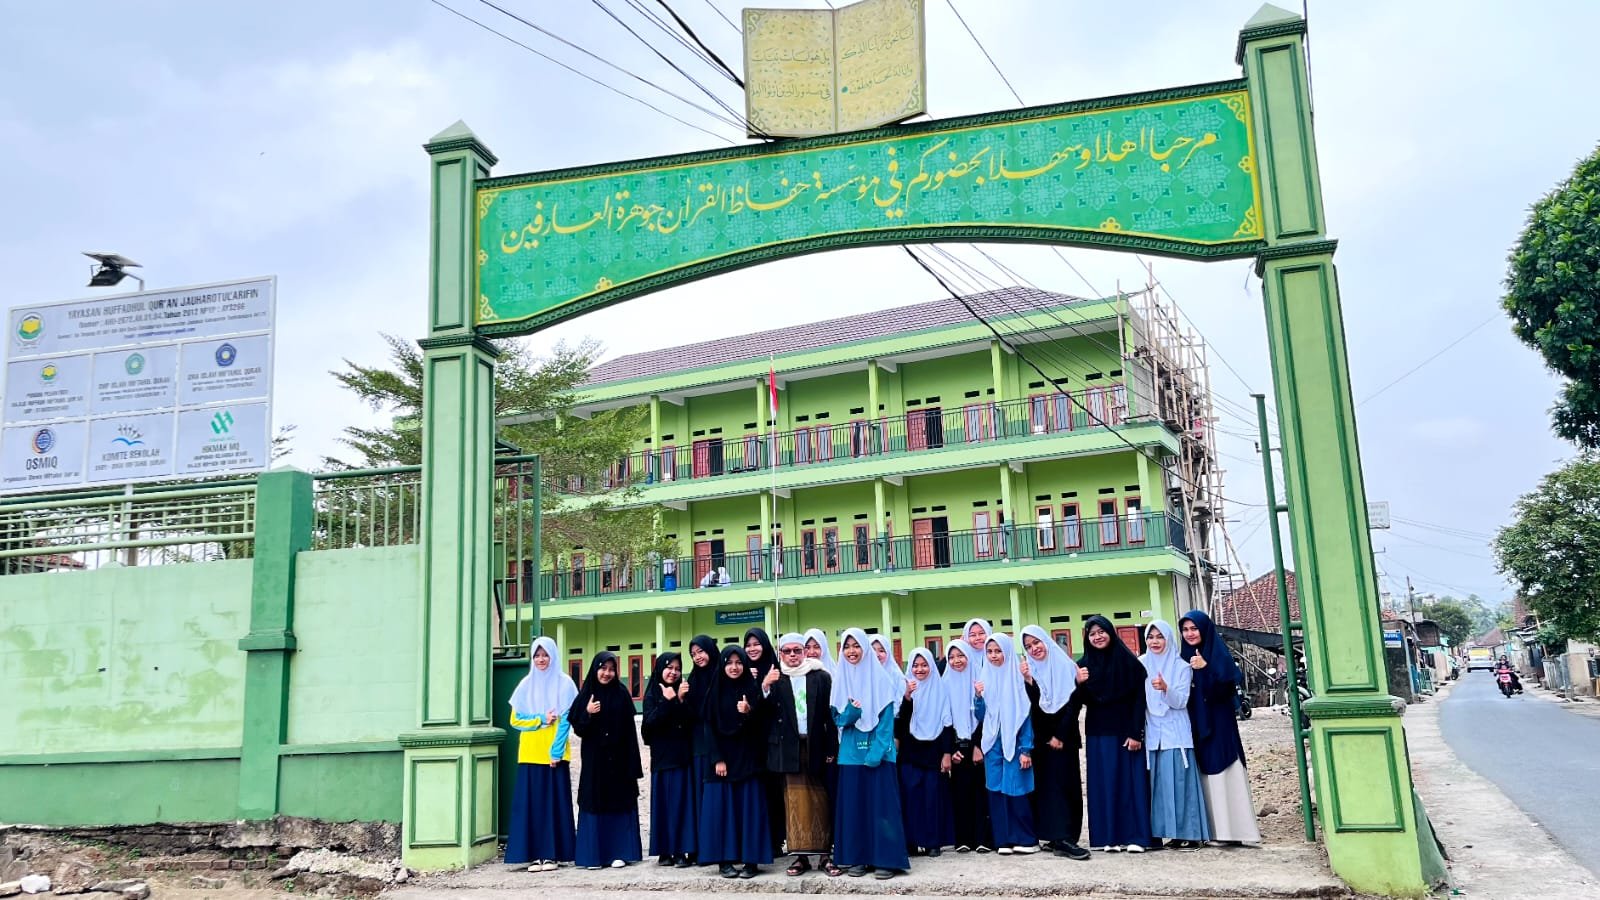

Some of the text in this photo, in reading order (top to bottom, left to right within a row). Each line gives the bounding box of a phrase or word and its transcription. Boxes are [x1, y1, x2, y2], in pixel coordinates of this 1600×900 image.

[1149, 127, 1217, 173] مرحبا
[873, 146, 903, 220] في
[501, 195, 613, 254] العارفين
[615, 189, 666, 233] جوهرة
[68, 308, 101, 320] YAYASAN
[148, 298, 179, 312] QUR'AN
[26, 455, 58, 471] OSMIQ
